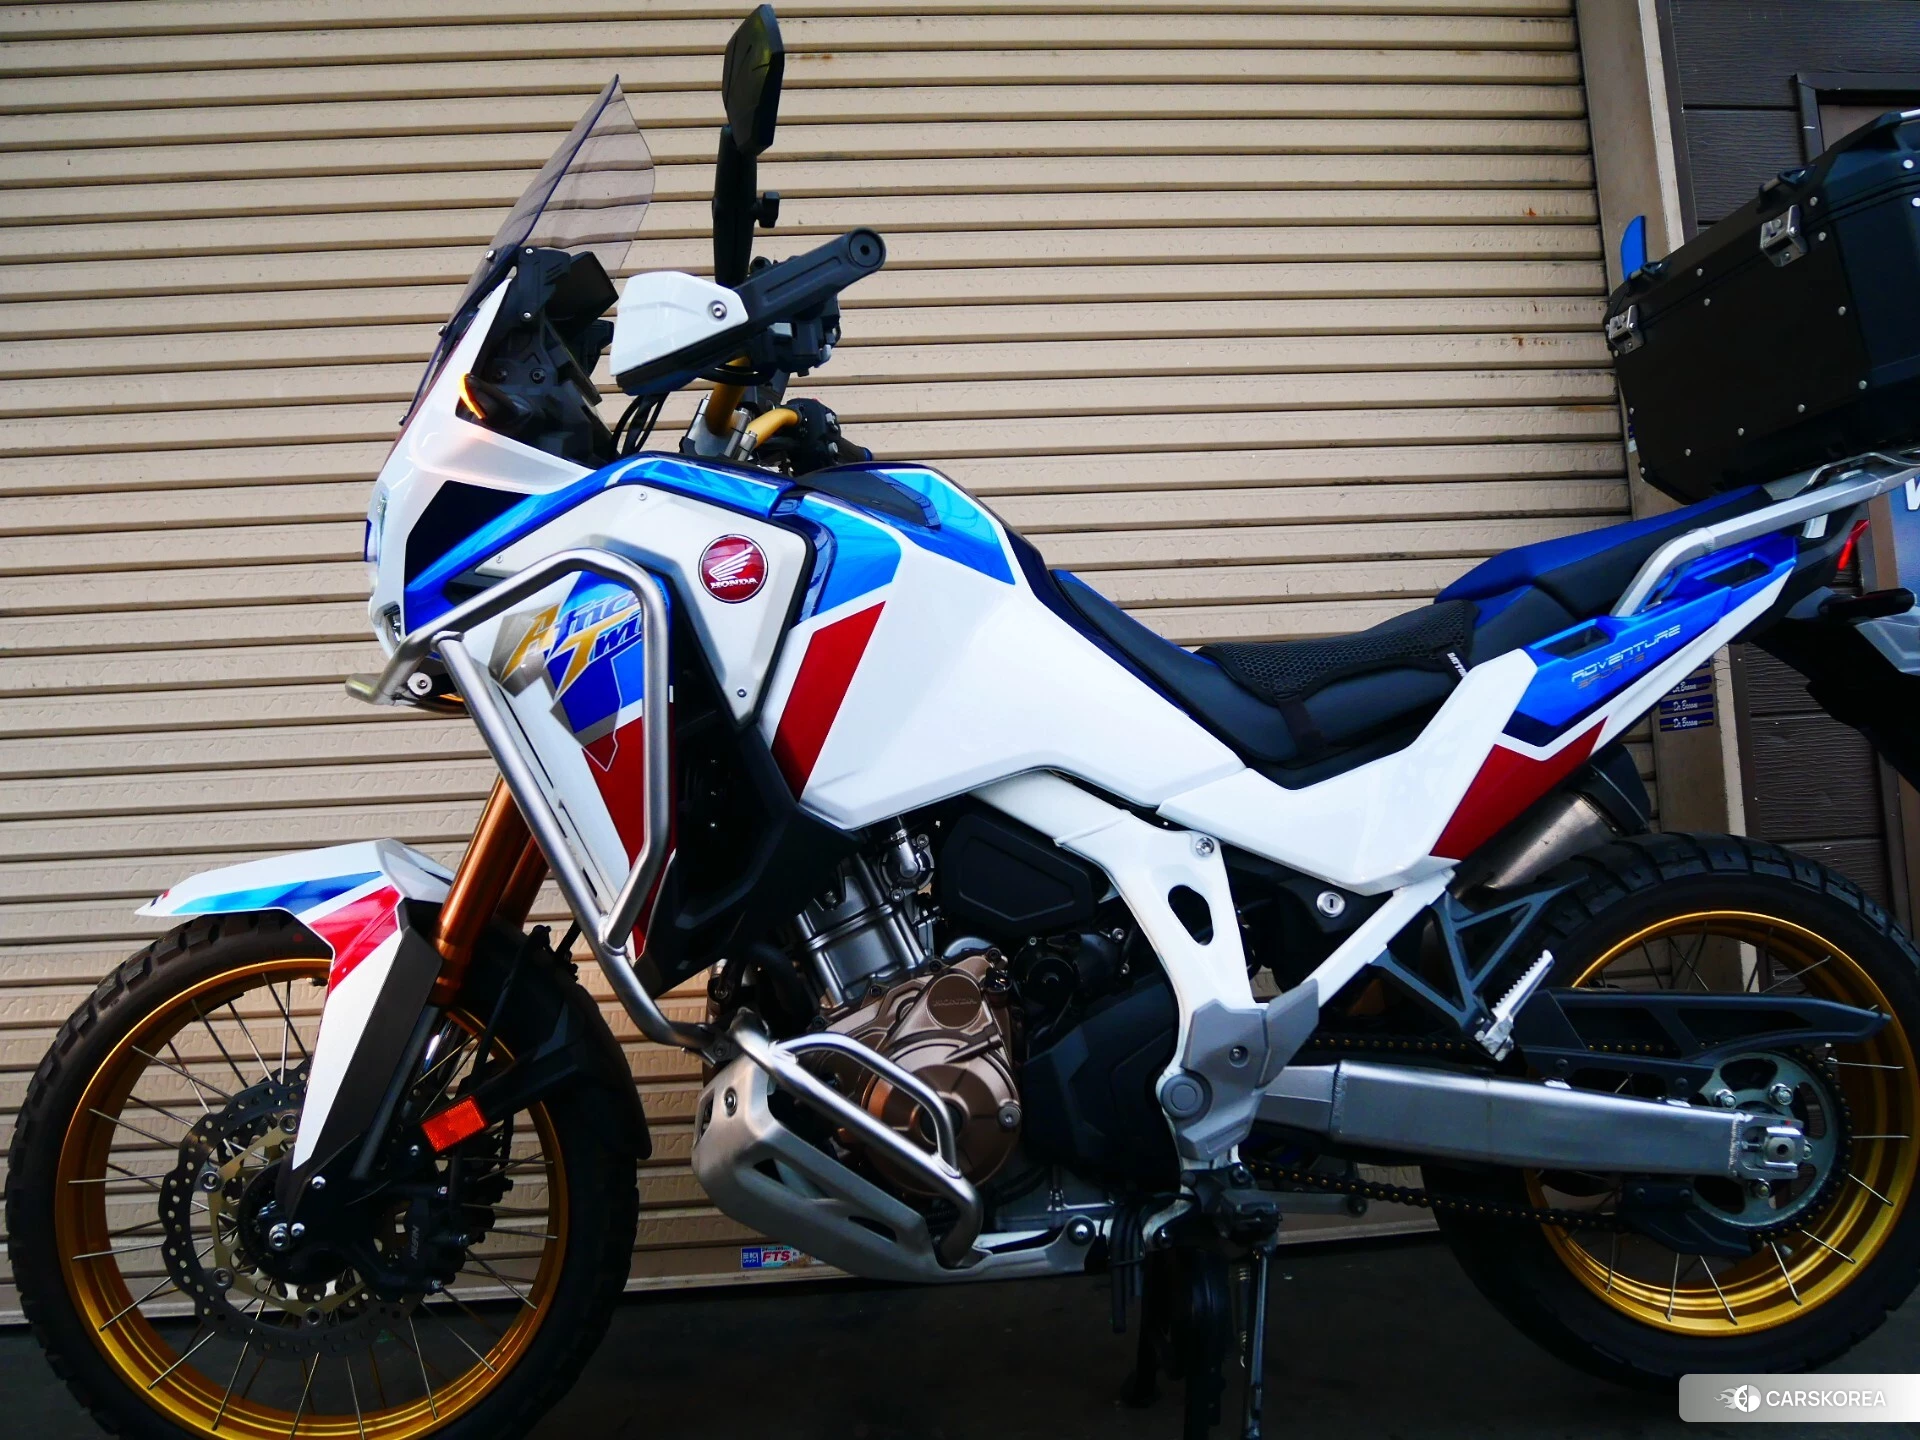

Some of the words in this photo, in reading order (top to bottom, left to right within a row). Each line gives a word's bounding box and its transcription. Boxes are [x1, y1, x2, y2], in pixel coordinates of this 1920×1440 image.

[710, 577, 758, 589] HONDA
[1571, 624, 1681, 683] ADVENTURE
[1578, 652, 1645, 689] SPORTS
[762, 1250, 791, 1262] FTS
